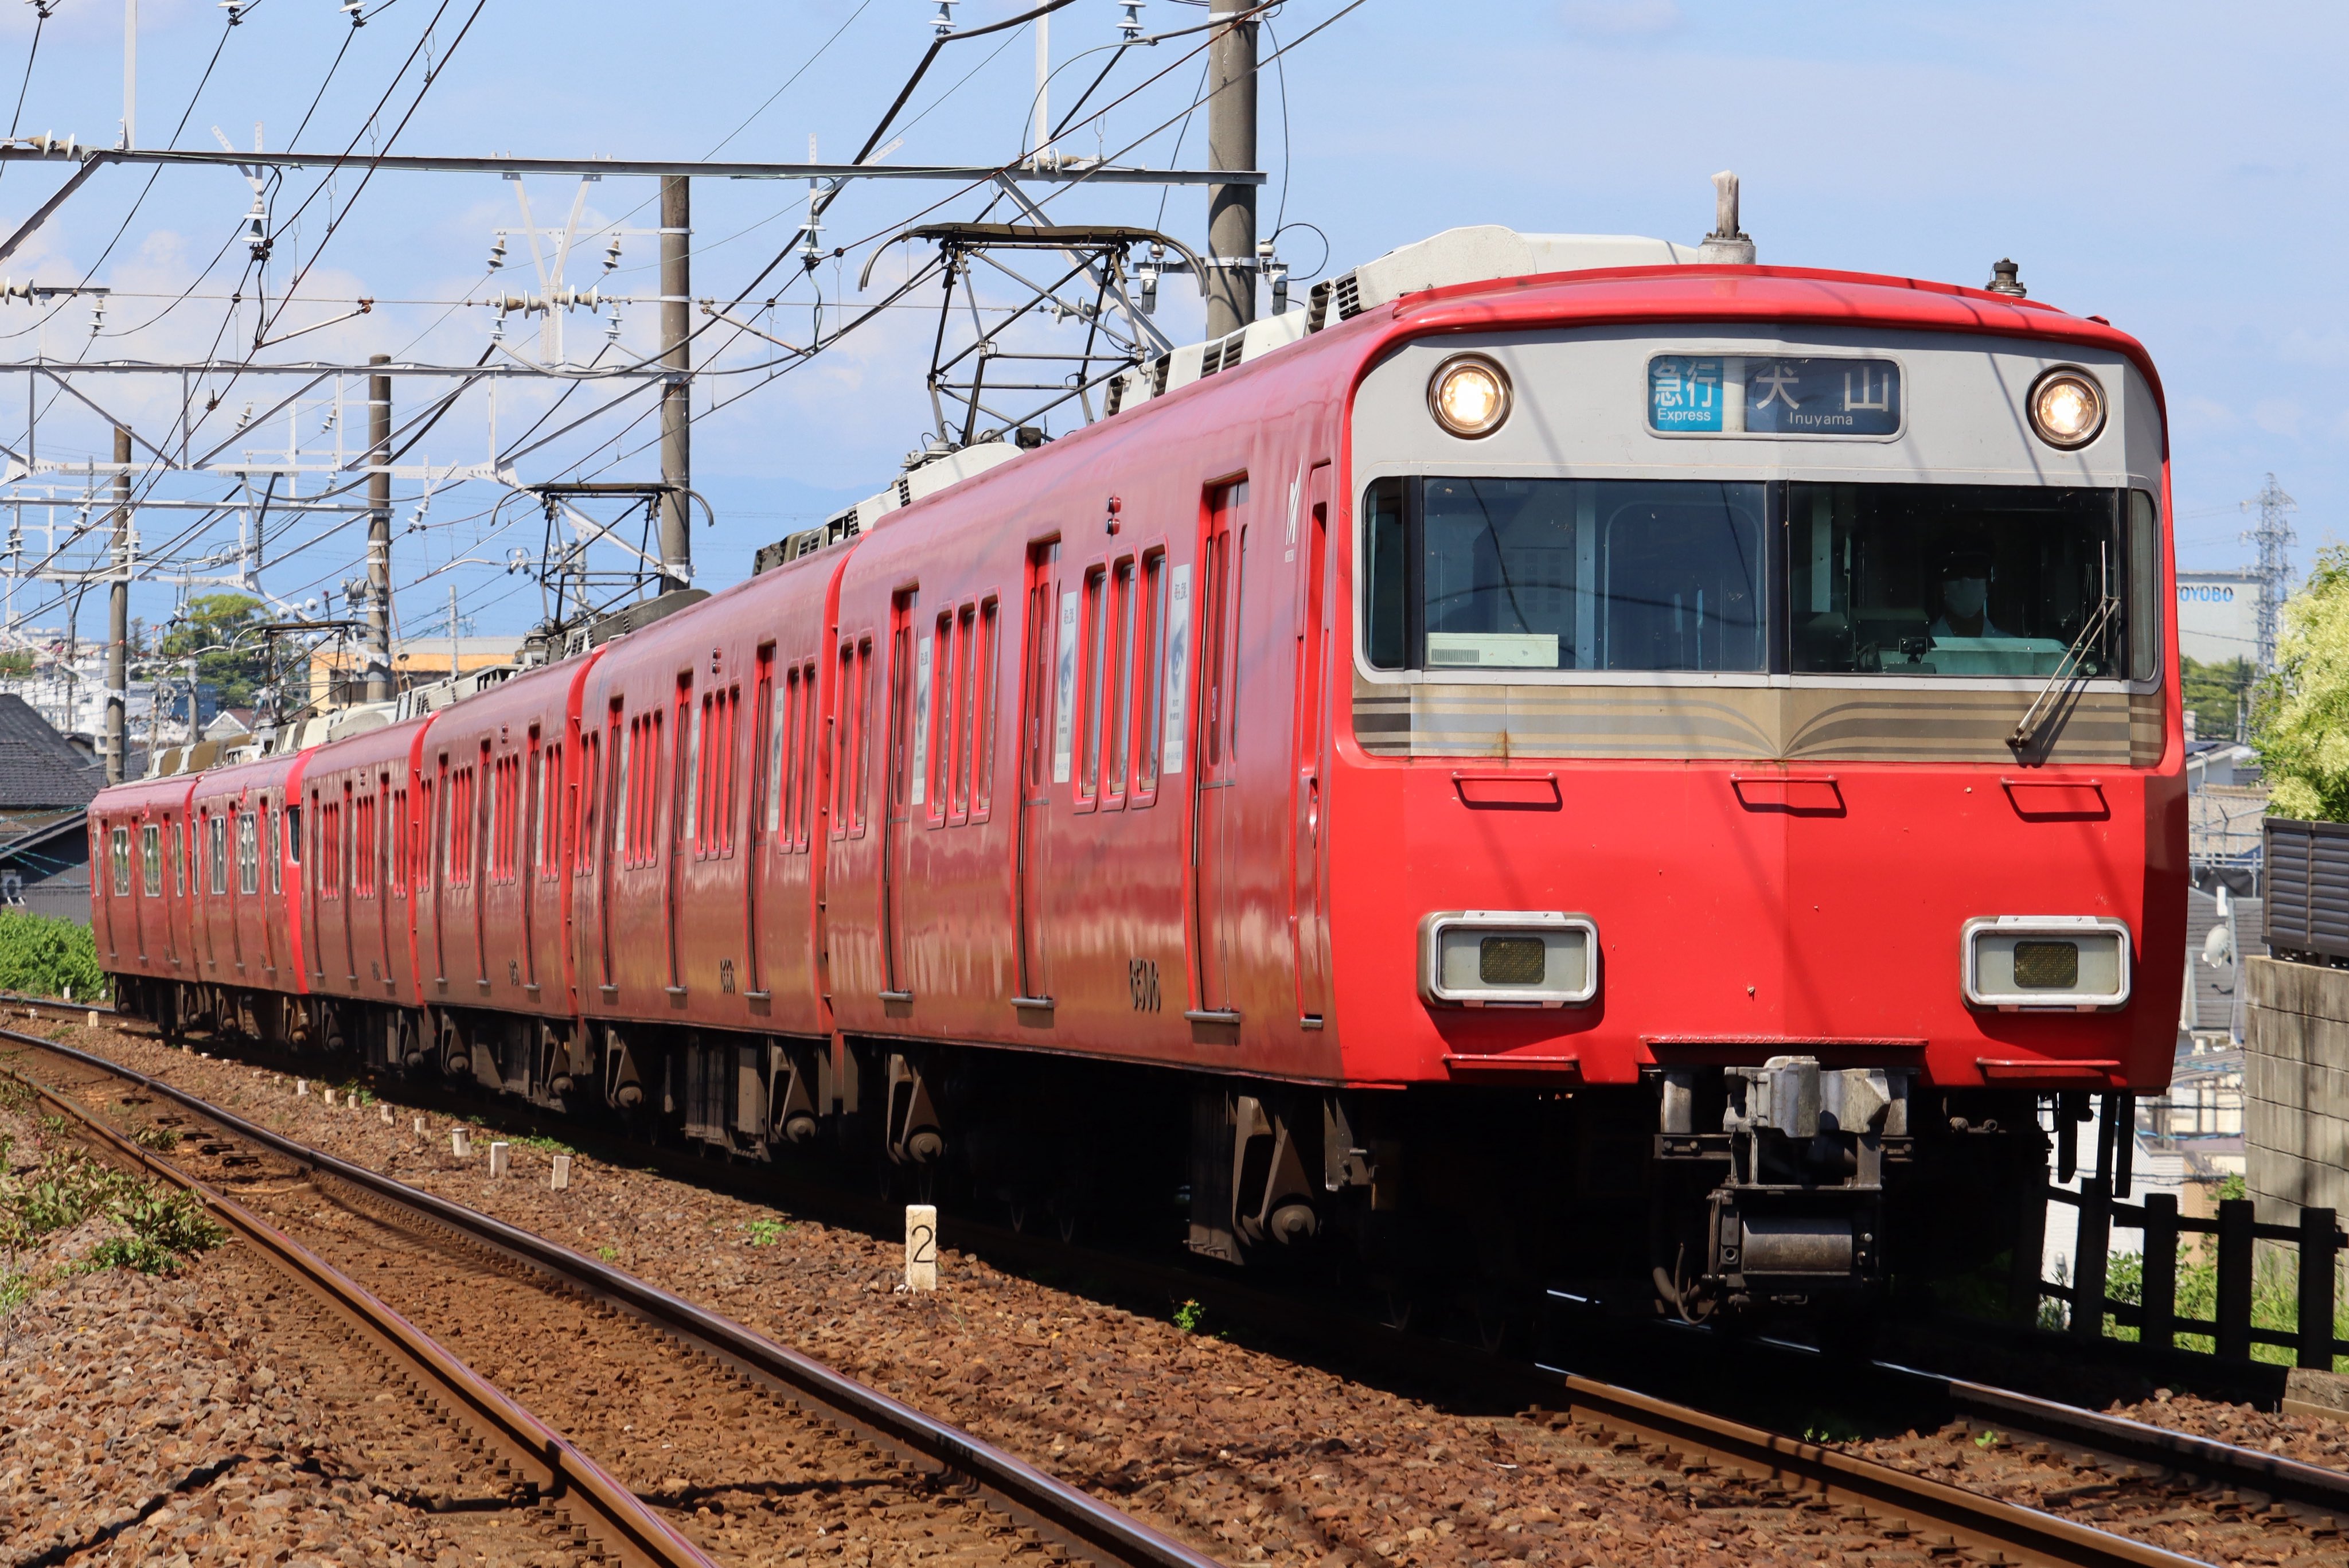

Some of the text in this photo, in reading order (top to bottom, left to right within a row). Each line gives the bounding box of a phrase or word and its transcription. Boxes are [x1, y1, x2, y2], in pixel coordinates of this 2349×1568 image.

[1653, 361, 1716, 407] 急行
[1756, 365, 1888, 412] 犬山
[1657, 409, 1711, 423] Express
[1790, 412, 1853, 427] Inuyama
[2178, 586, 2234, 602] OYOBO
[912, 1224, 934, 1263] 2
